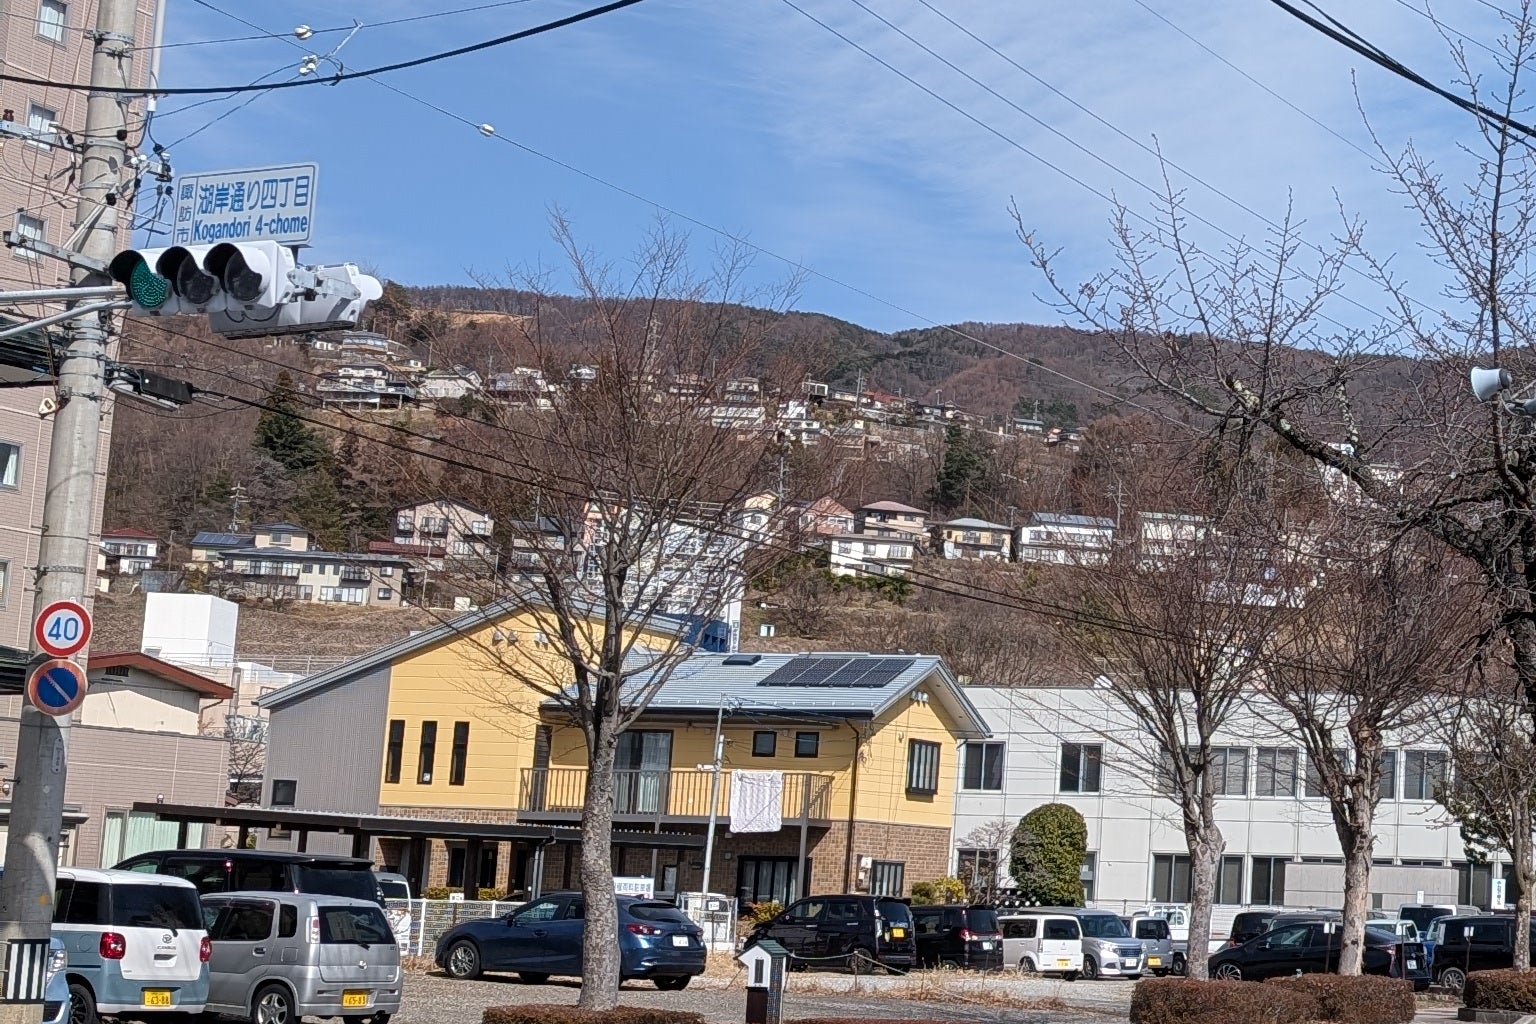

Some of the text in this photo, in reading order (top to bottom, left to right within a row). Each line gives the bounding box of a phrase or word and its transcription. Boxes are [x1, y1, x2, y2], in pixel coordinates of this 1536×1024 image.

[197, 175, 310, 215] 湖岸通り四丁目
[177, 183, 194, 243] 諏訪市
[193, 213, 308, 243] Kogandori 4-chome
[47, 616, 79, 641] 40
